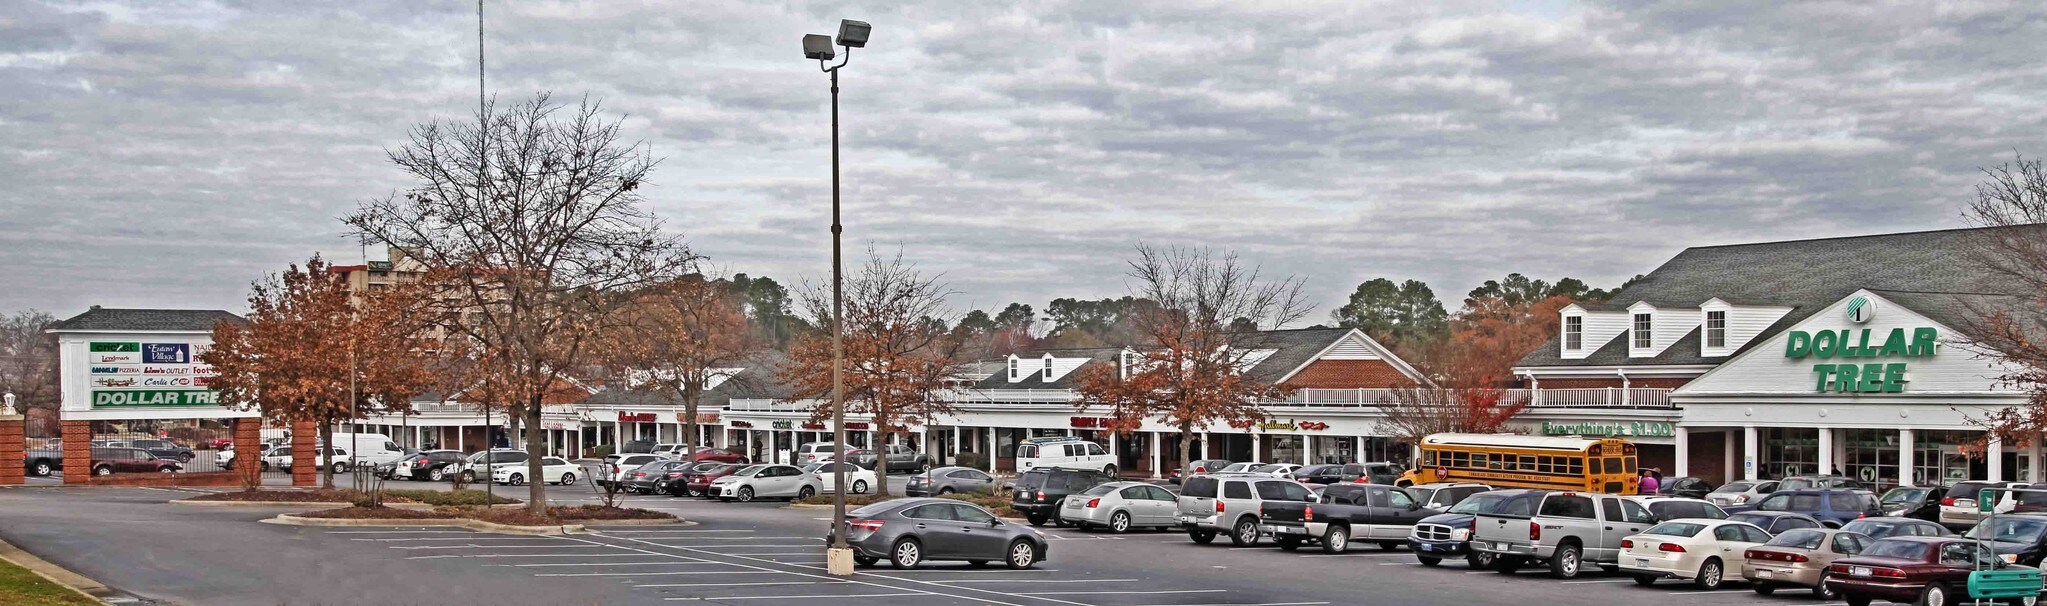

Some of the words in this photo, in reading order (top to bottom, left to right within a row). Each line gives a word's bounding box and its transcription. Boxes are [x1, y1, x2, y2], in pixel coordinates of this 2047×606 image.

[96, 344, 135, 352] cricket
[1785, 327, 1938, 358] DOLLAR
[152, 352, 174, 362] Village
[193, 366, 209, 374] Foot
[1813, 363, 1907, 393] TREE
[96, 391, 179, 405] DOLLAR
[184, 391, 222, 404] TRE
[1257, 417, 1298, 432] Hallmark
[1542, 421, 1625, 437] Everything's
